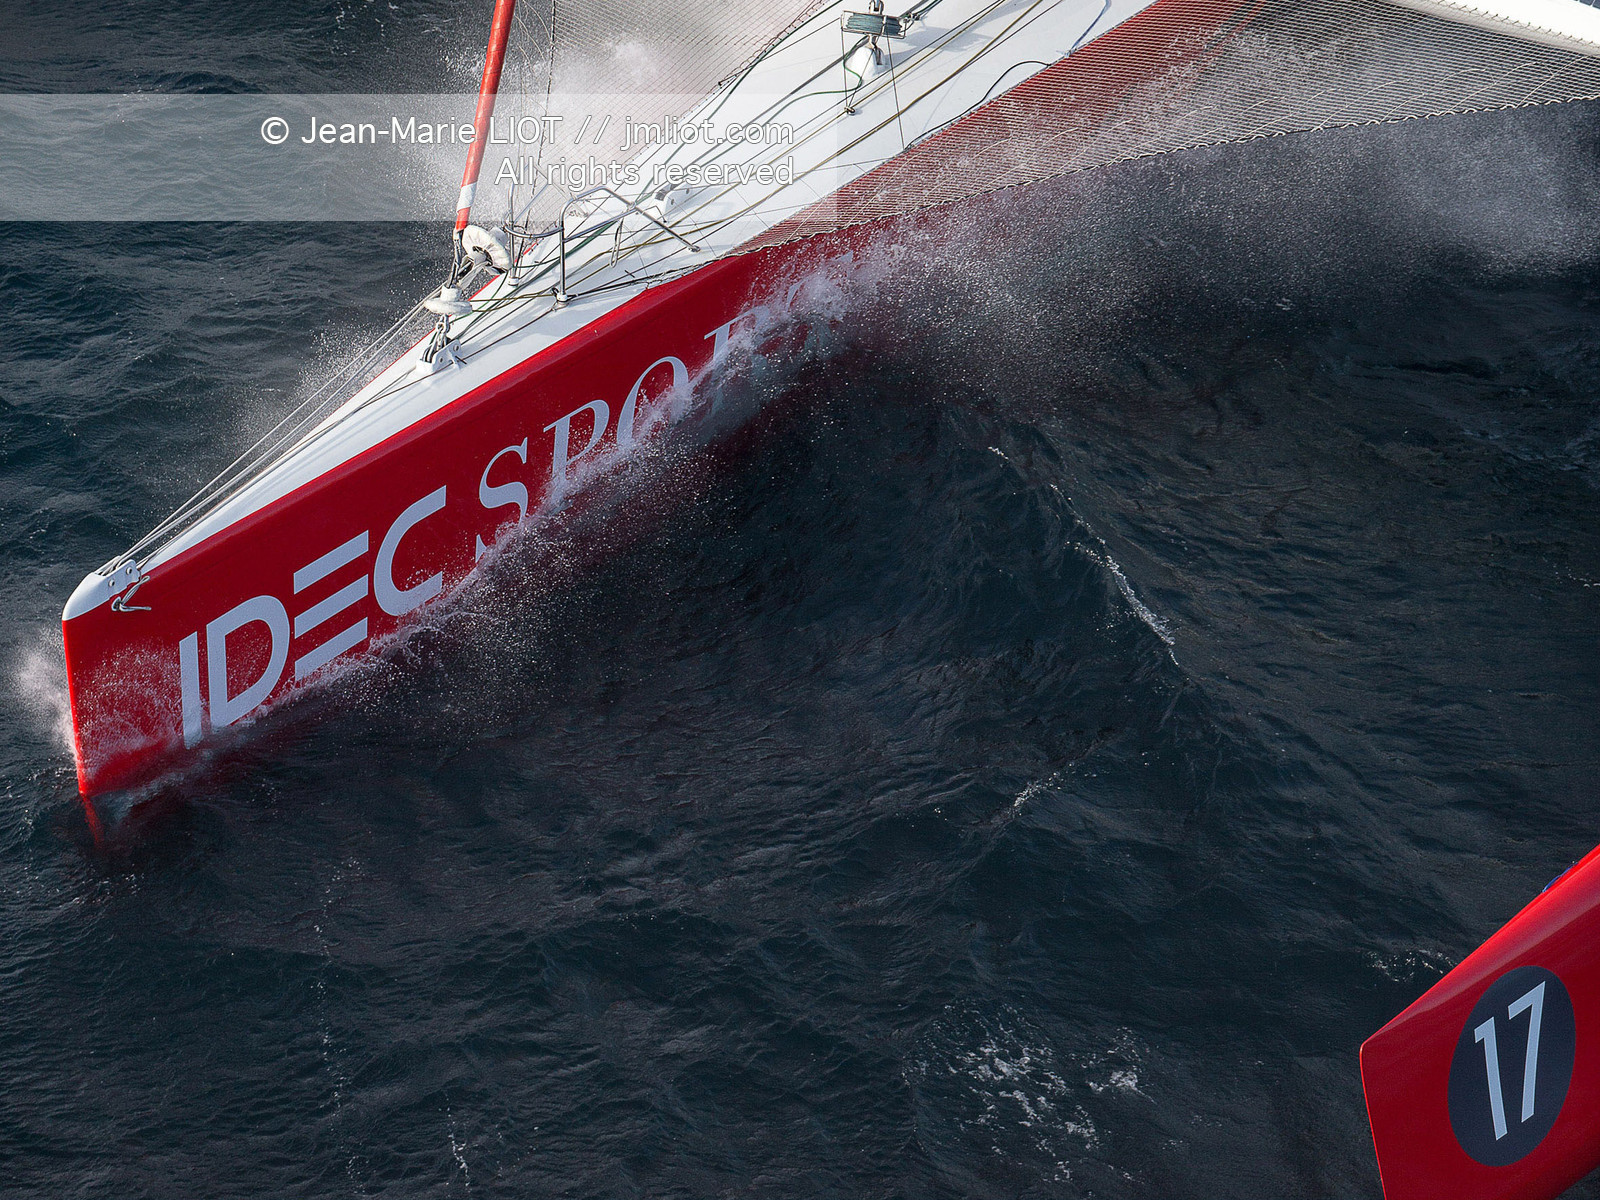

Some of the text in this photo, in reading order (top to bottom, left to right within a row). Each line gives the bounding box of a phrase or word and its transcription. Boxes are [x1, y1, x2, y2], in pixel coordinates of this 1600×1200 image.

[179, 284, 798, 749] IDEC SPO
[1474, 981, 1546, 1141] 17
